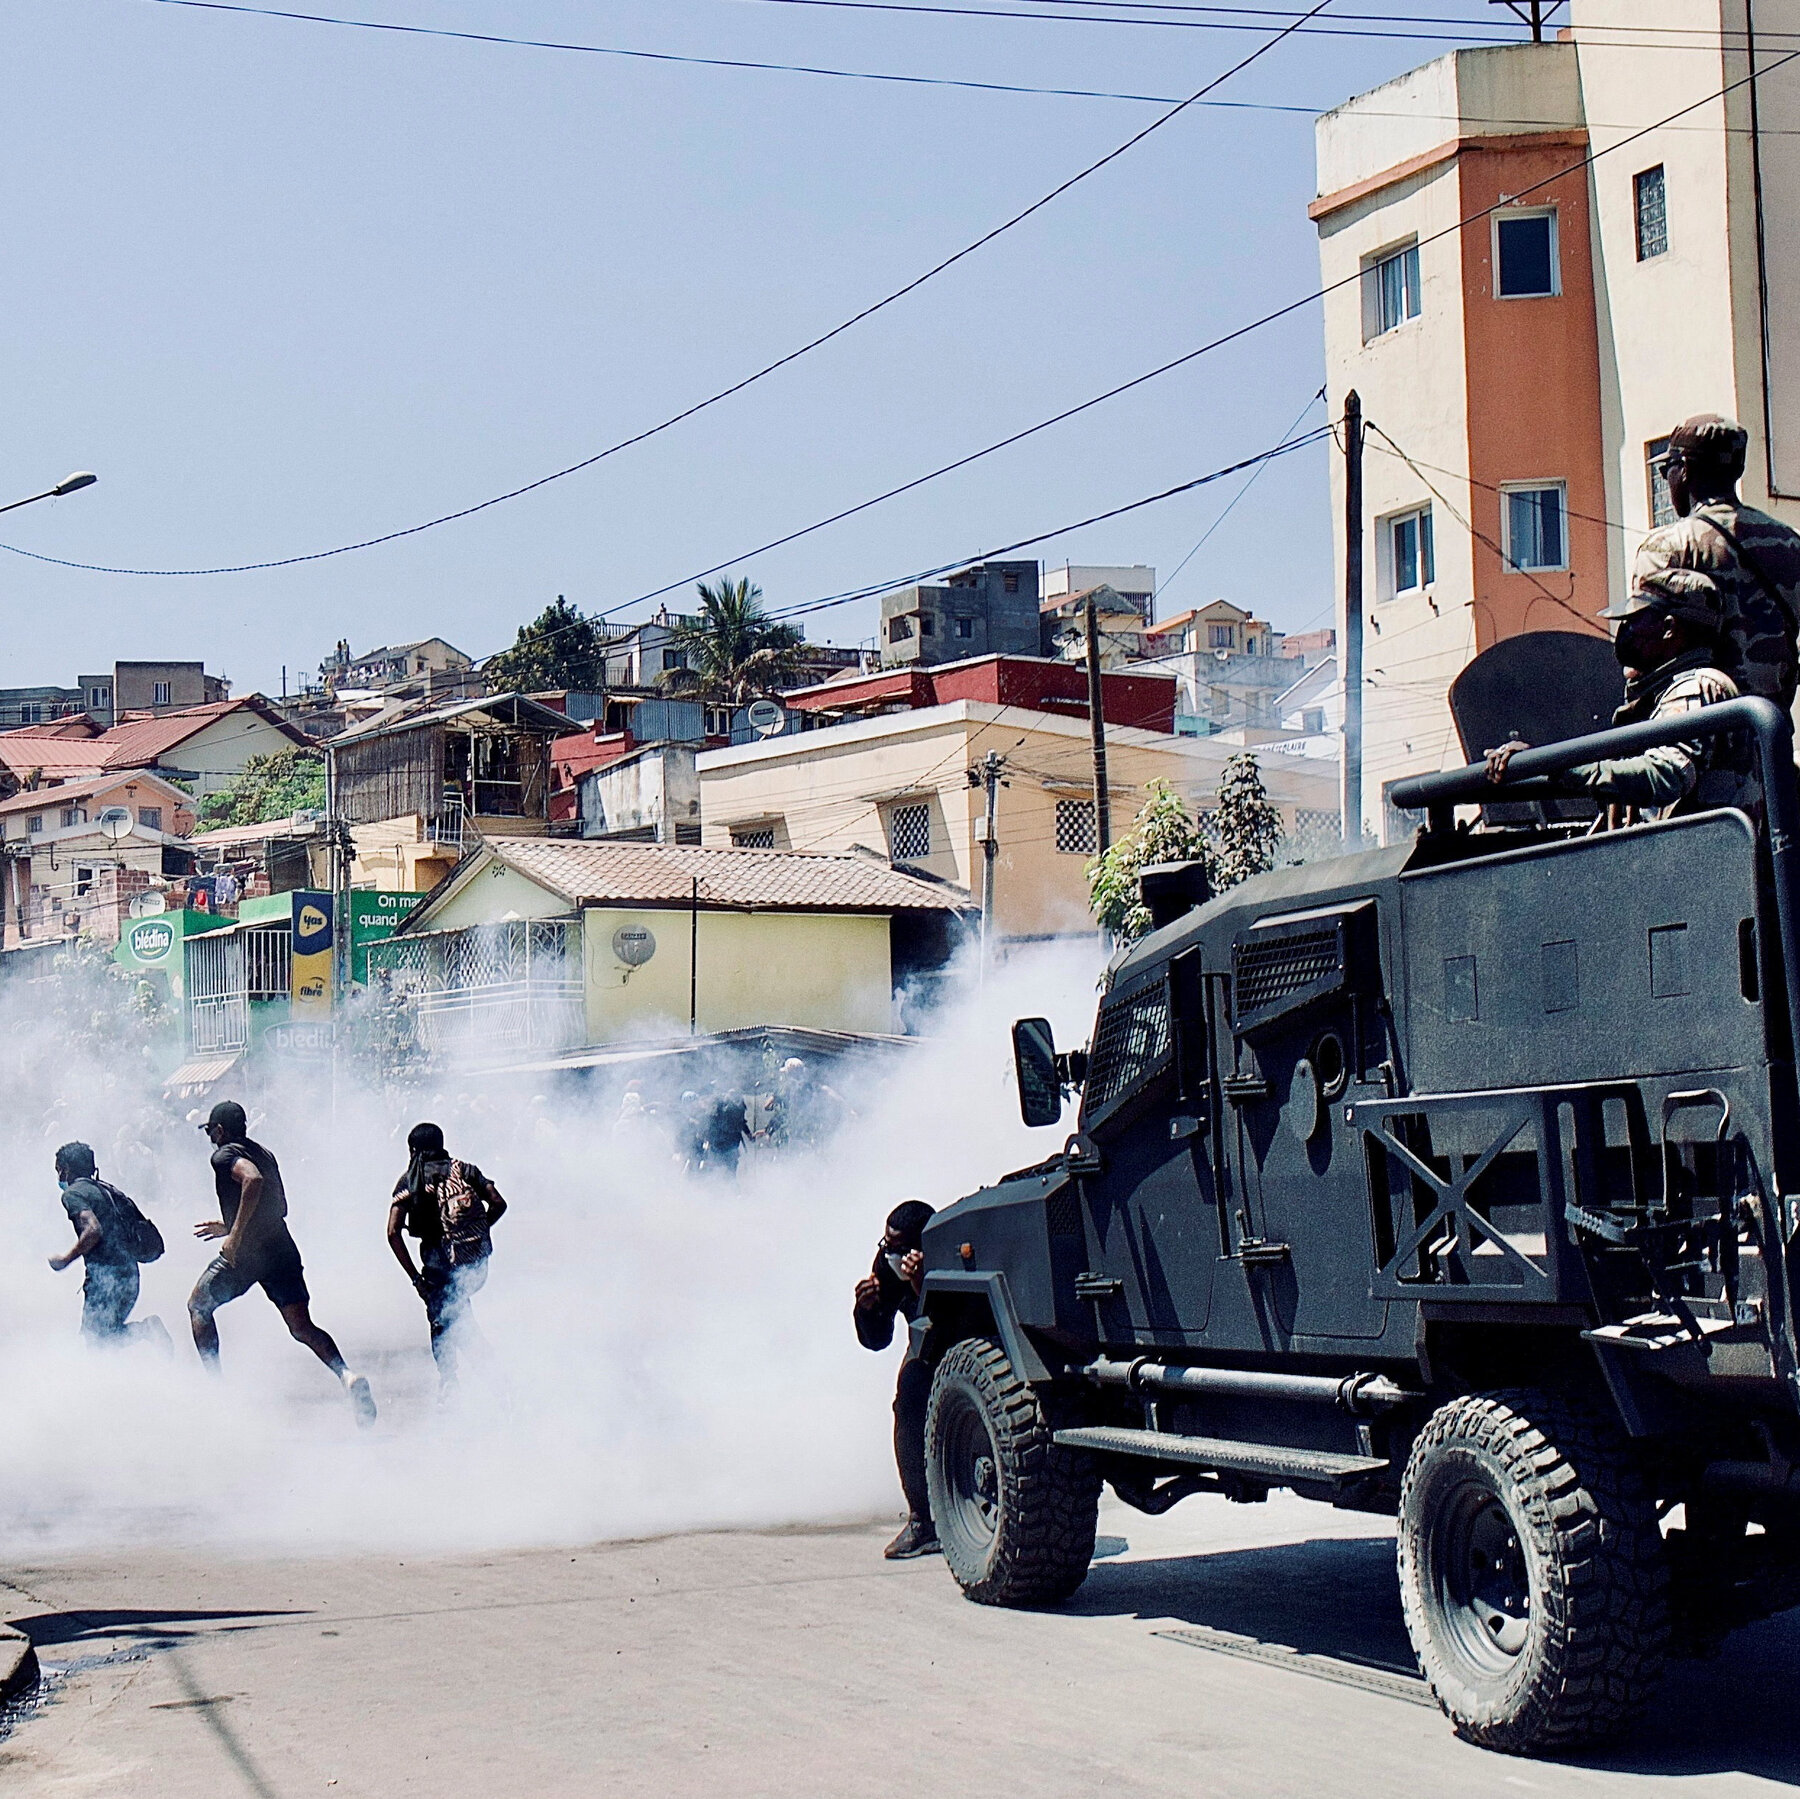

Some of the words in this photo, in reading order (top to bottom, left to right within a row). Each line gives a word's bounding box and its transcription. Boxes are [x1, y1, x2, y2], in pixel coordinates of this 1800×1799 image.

[378, 894, 396, 908] On
[359, 912, 398, 929] quand
[134, 928, 169, 950] blédina
[300, 986, 323, 997] fibre
